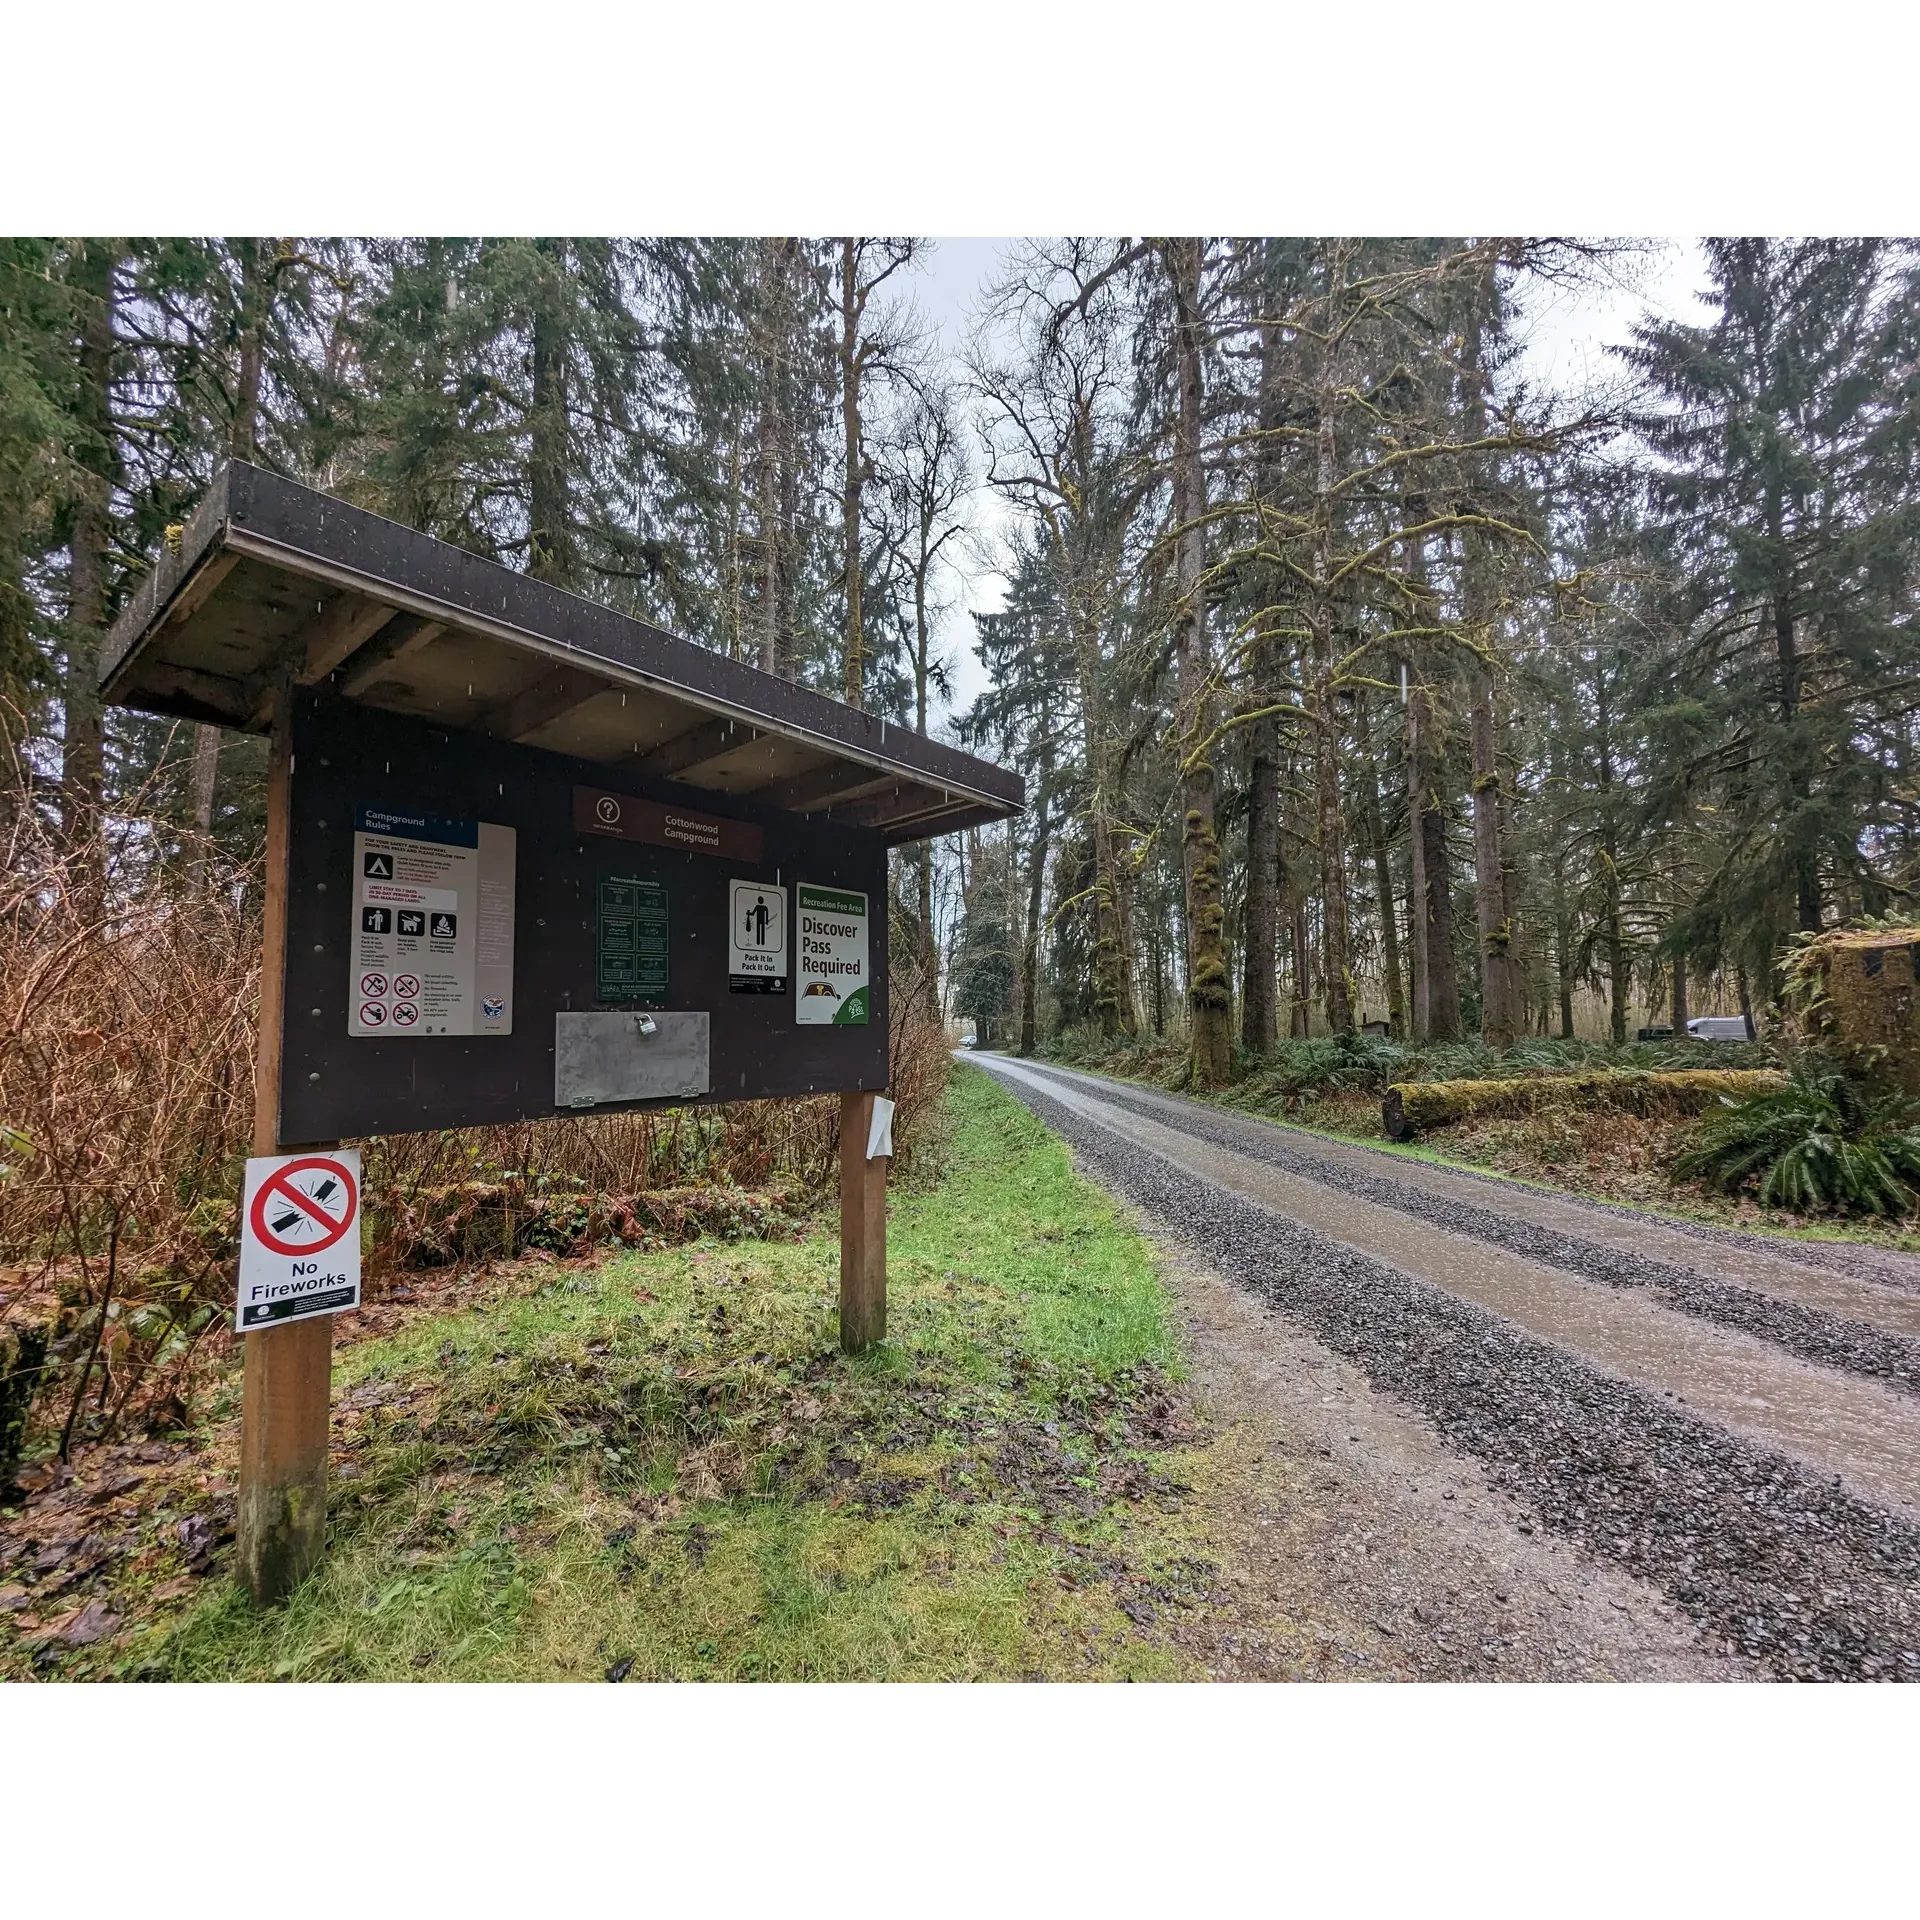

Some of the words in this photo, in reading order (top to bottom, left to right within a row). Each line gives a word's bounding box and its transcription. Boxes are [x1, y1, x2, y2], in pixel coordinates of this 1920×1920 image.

[366, 810, 425, 826] Campground
[366, 820, 391, 830] Rules
[666, 815, 719, 834] Cottonwood
[664, 828, 719, 846] Campground
[803, 897, 836, 909] Recreation
[837, 902, 847, 910] Fee
[848, 904, 862, 912] Area
[803, 917, 857, 938] Discover
[803, 937, 831, 954] Pass
[803, 956, 860, 977] Required
[292, 1262, 317, 1277] No
[252, 1273, 346, 1300] Fireworks
